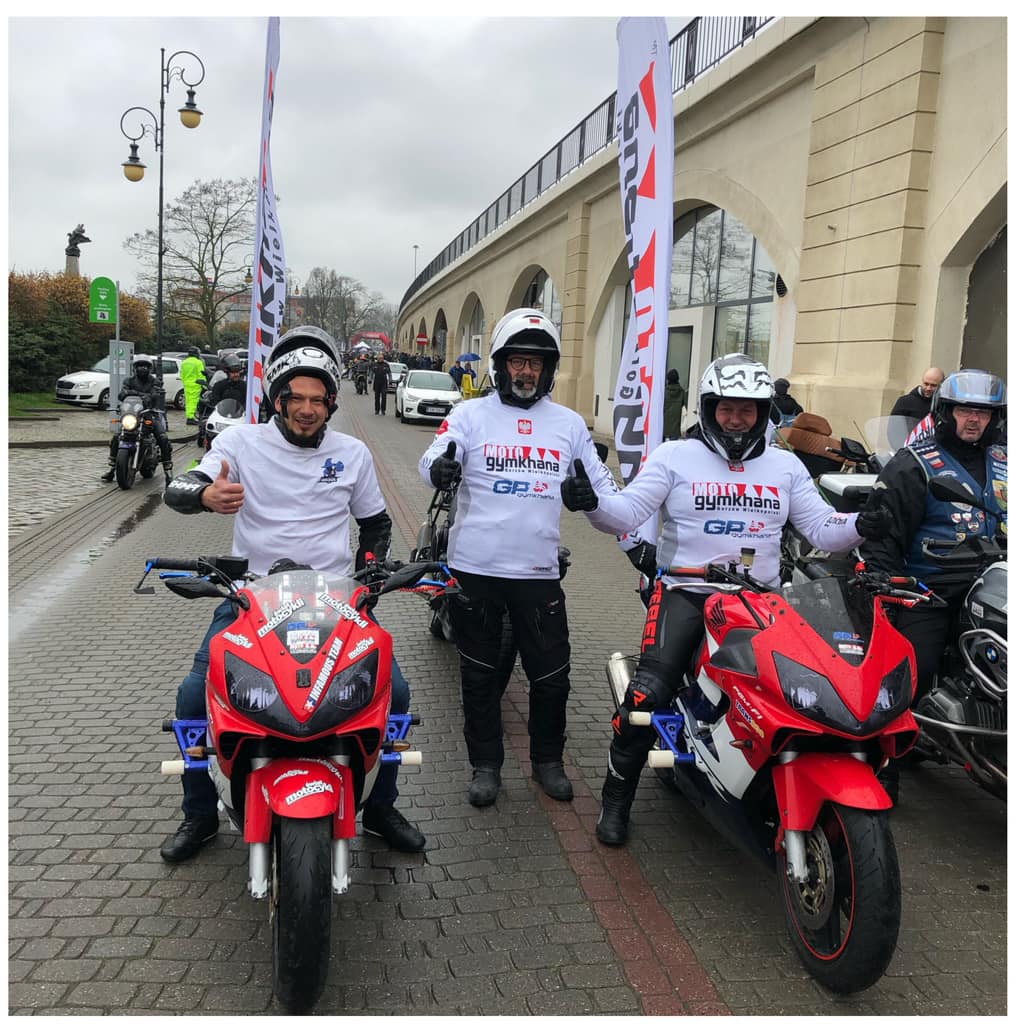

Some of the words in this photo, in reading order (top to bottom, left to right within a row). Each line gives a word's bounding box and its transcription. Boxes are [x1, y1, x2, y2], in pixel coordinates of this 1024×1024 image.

[486, 457, 560, 473] gymkhana
[493, 480, 530, 495] GP
[694, 493, 781, 511] gymkhana
[703, 519, 747, 535] GP
[257, 598, 305, 638] motocykli
[319, 592, 368, 629] motocykli
[641, 579, 664, 653] REBEL
[310, 656, 336, 700] INFAMOUS
[331, 637, 344, 660] TEAM
